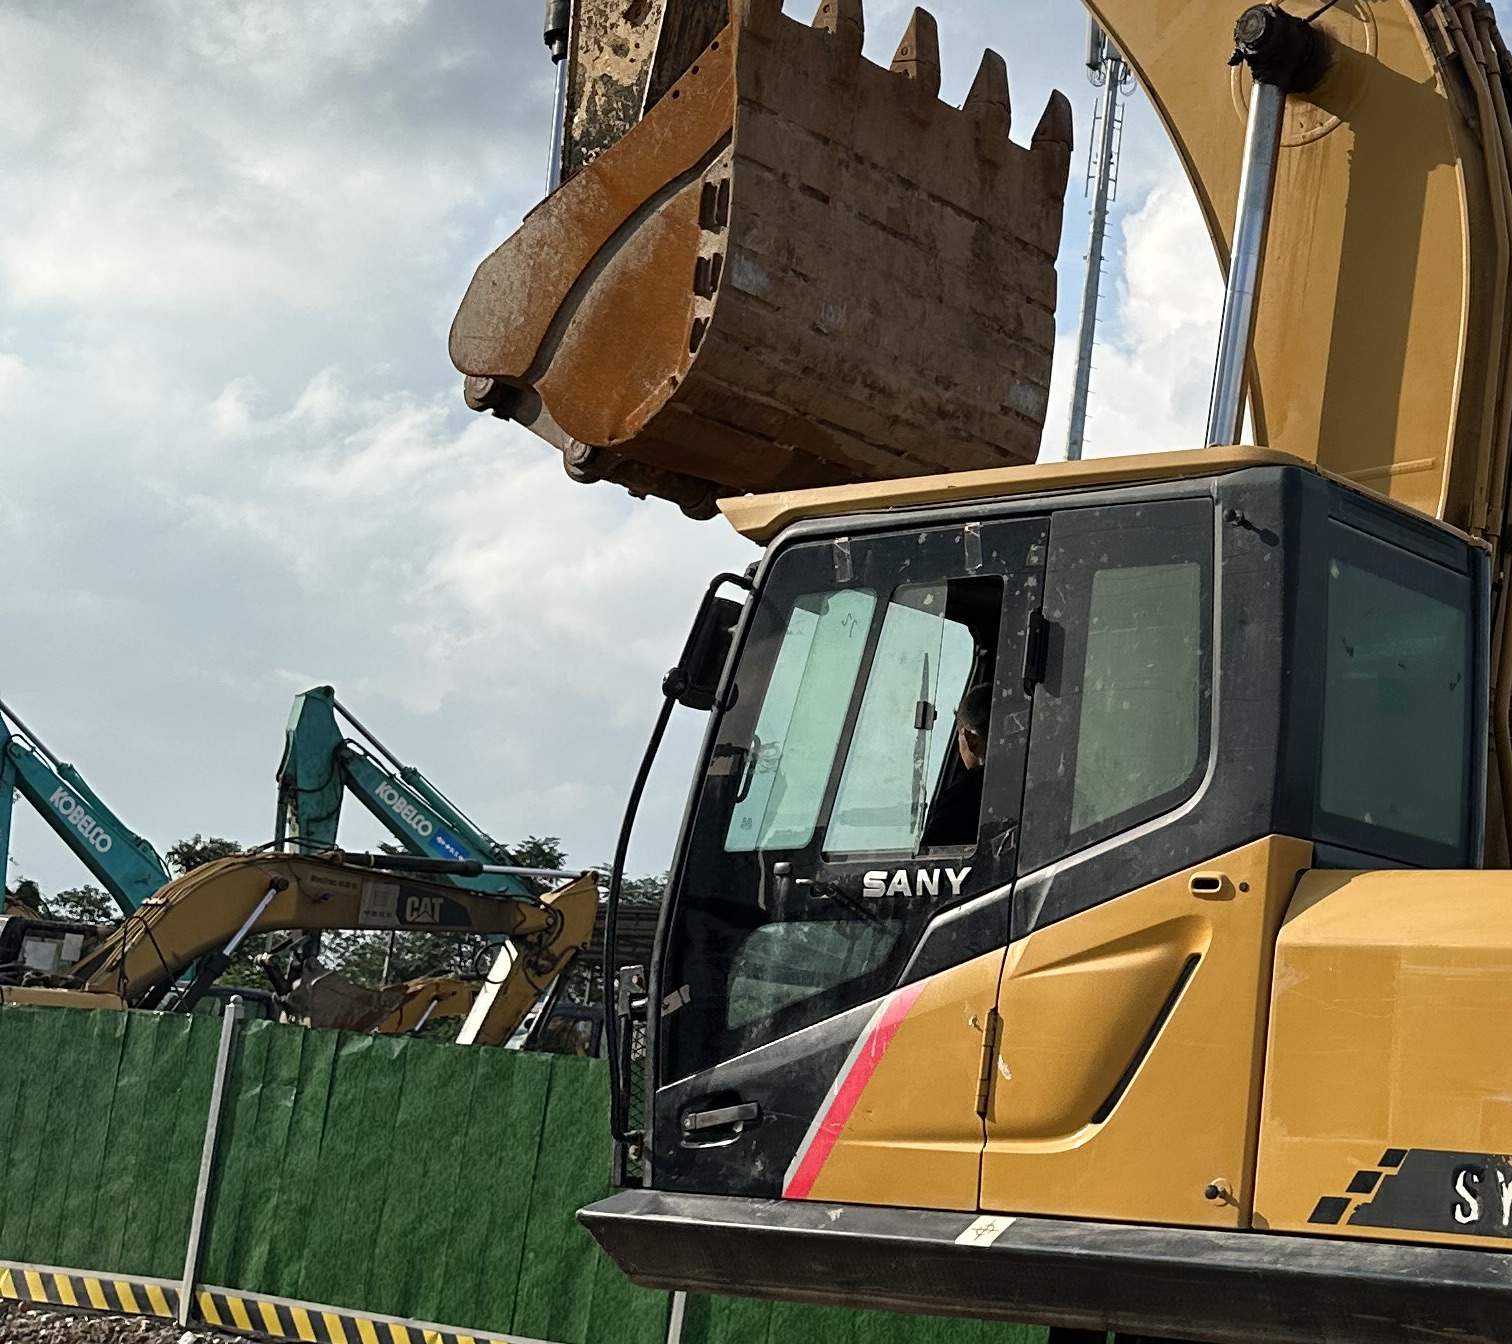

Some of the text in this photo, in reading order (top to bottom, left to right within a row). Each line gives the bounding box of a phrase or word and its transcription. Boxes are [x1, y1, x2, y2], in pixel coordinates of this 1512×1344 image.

[48, 786, 113, 854] KOBELCO
[375, 781, 433, 837] KOBELCO
[862, 866, 973, 898] SANY
[405, 895, 445, 924] CAT
